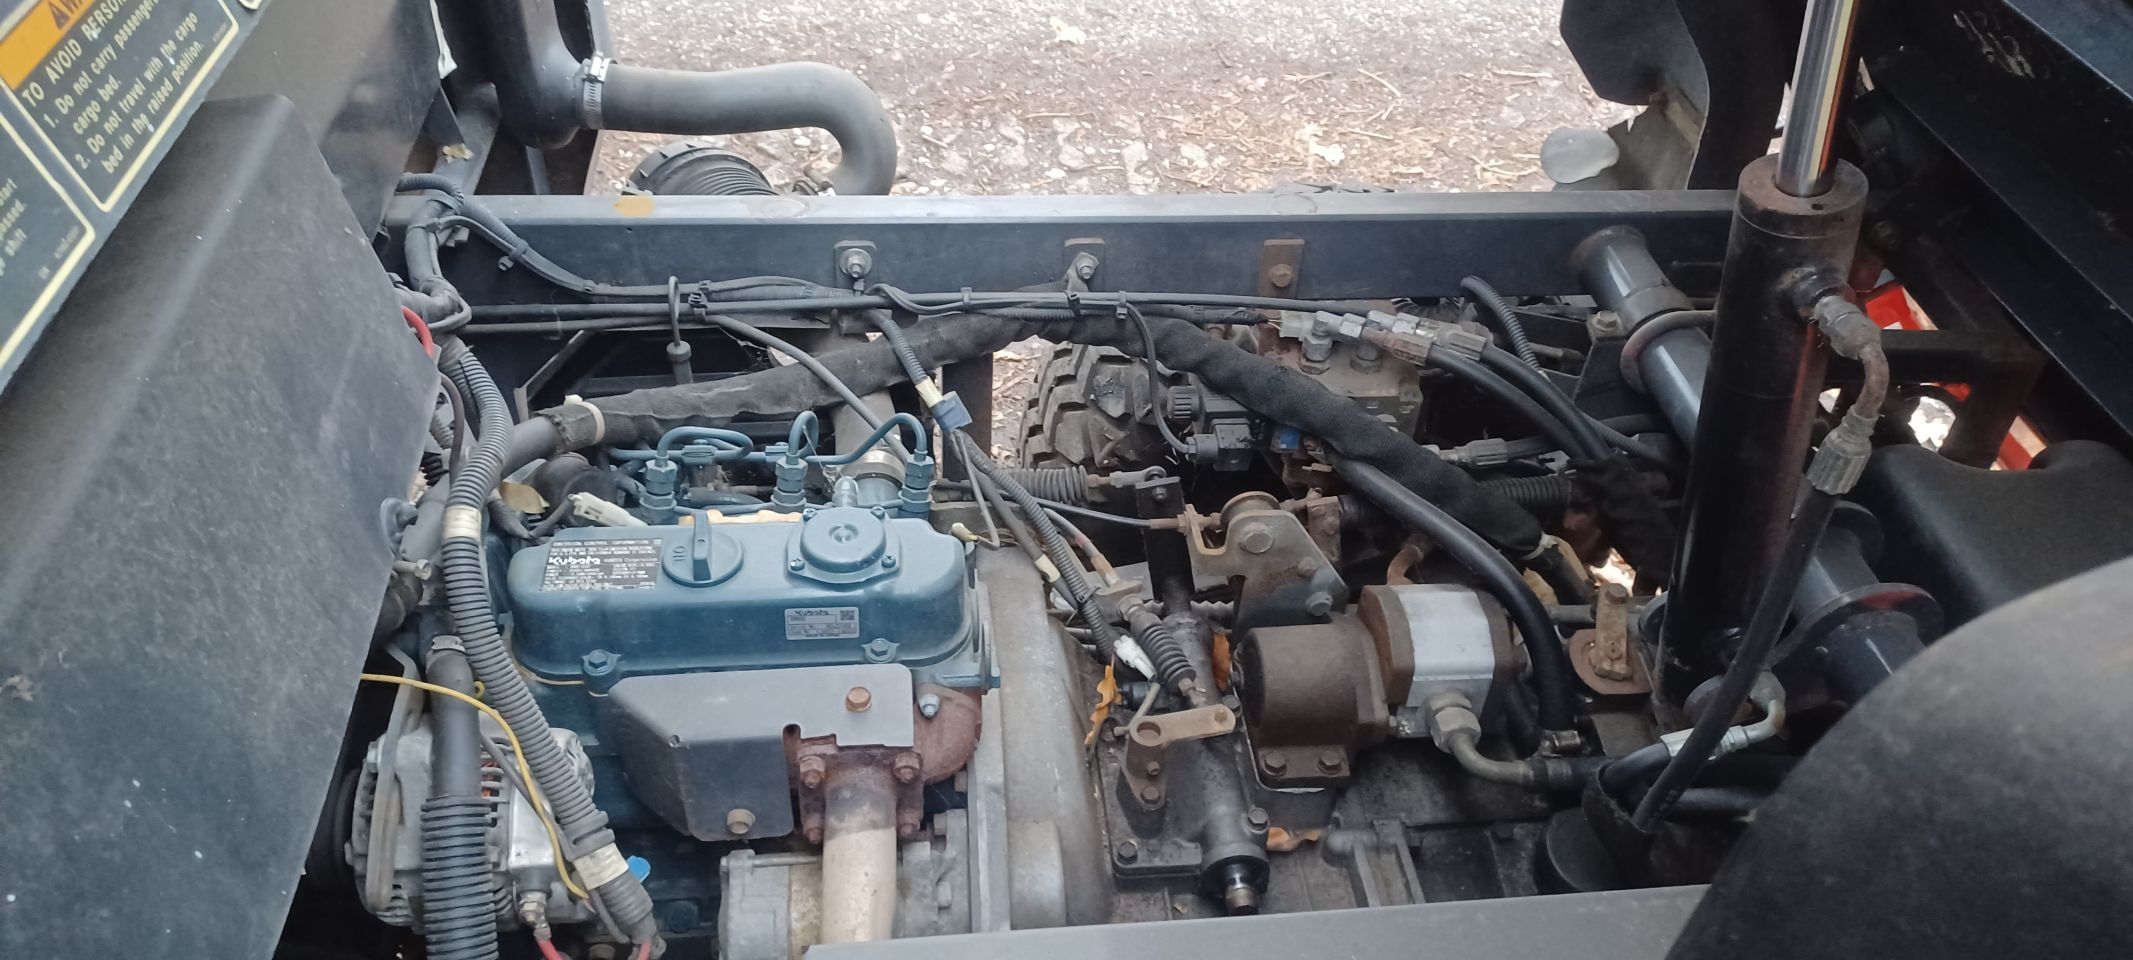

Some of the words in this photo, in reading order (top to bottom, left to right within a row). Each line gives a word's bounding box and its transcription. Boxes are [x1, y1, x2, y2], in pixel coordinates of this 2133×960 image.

[22, 81, 45, 108] TO
[45, 38, 82, 85] AVOID
[44, 113, 60, 129] 1.
[54, 94, 74, 114] Do
[73, 70, 93, 96] not
[90, 44, 118, 75] carry
[73, 100, 101, 135] cargo
[97, 74, 122, 102] bed.
[76, 154, 92, 171] 2.
[86, 134, 106, 154] Do
[104, 110, 122, 135] not
[118, 76, 146, 114] travel
[144, 56, 164, 83] with
[160, 38, 177, 60] the
[174, 11, 198, 50] cargo
[101, 149, 124, 176] bed
[120, 132, 135, 150] in
[131, 112, 150, 135] the
[147, 76, 174, 116] raised
[172, 42, 206, 84] position.
[548, 556, 601, 566] Kubota
